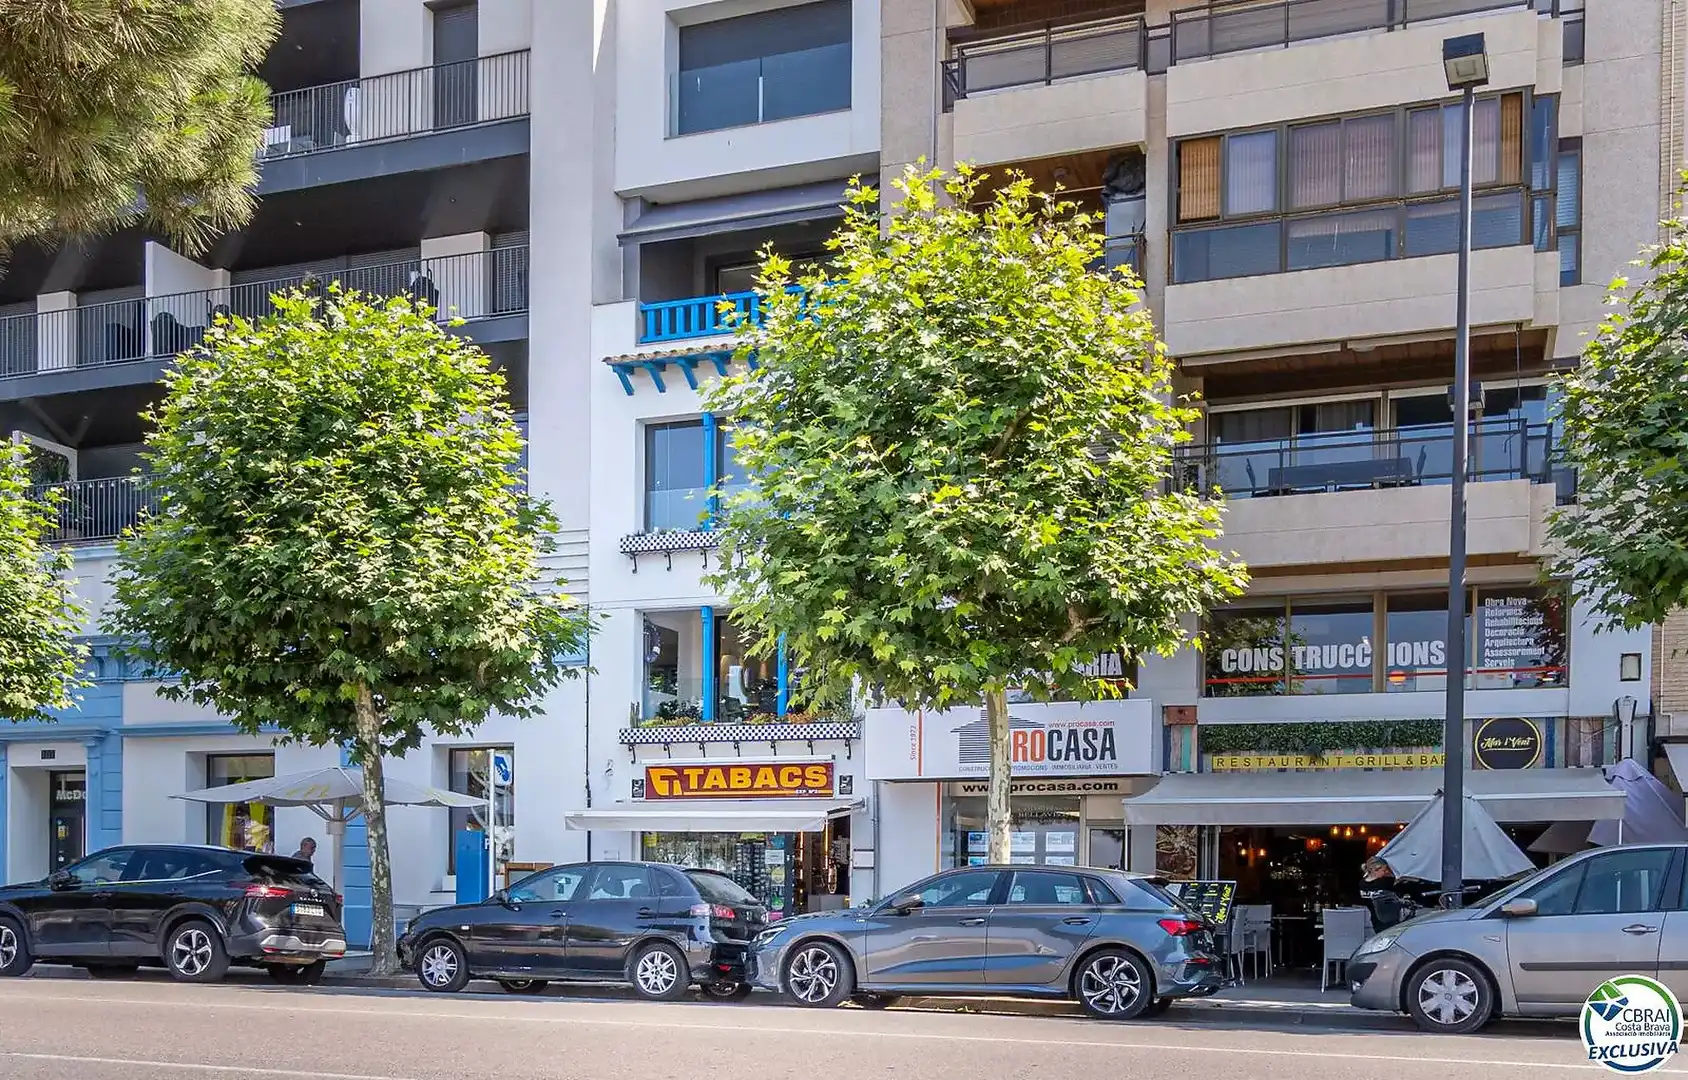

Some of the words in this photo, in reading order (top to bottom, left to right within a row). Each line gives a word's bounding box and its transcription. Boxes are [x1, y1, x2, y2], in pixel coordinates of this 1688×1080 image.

[1506, 597, 1527, 606] Nova
[1012, 728, 1116, 762] ROCASA
[684, 766, 828, 789] TABACS
[963, 782, 1119, 794] wwprocasa.com
